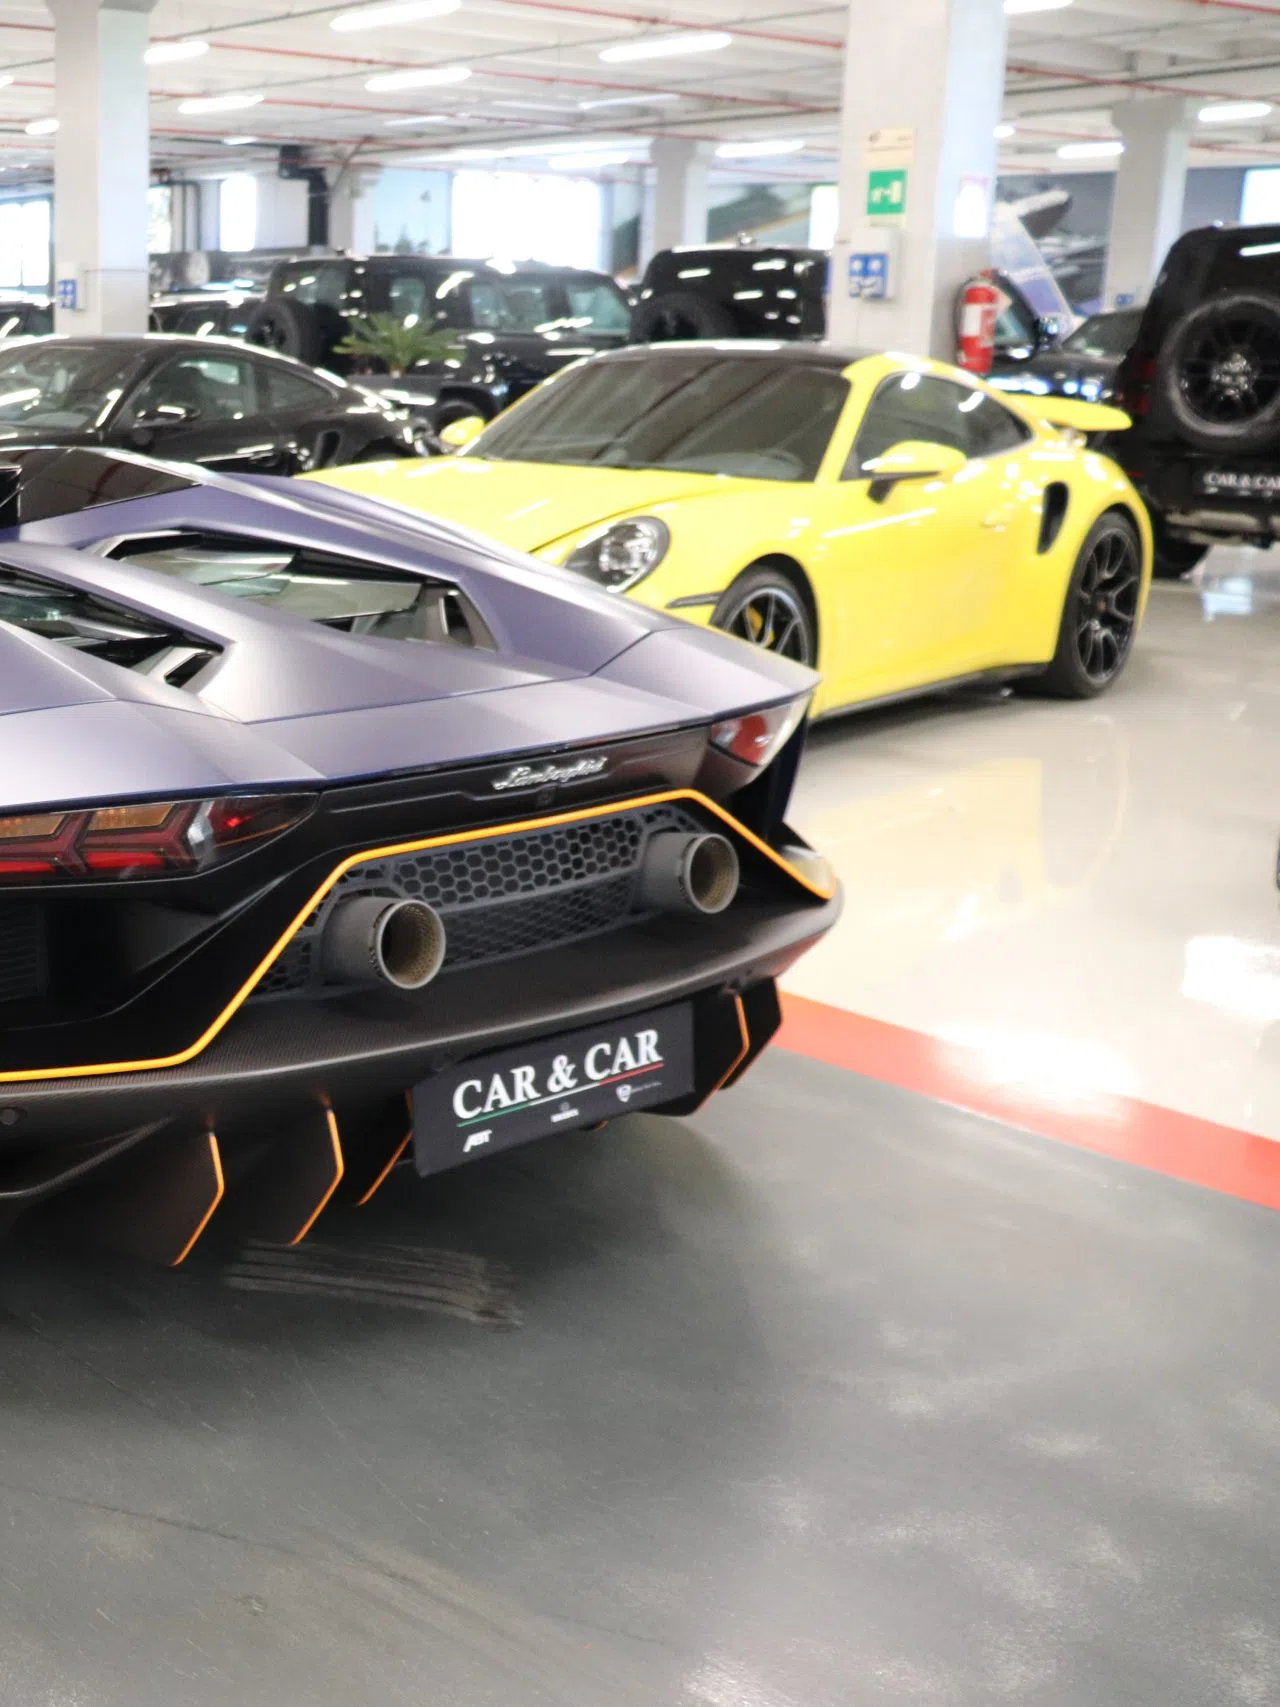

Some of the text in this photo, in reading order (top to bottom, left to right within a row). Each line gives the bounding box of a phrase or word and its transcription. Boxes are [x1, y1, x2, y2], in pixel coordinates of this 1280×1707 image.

[1203, 471, 1238, 488] CAR
[452, 1029, 663, 1120] CAR & CAR
